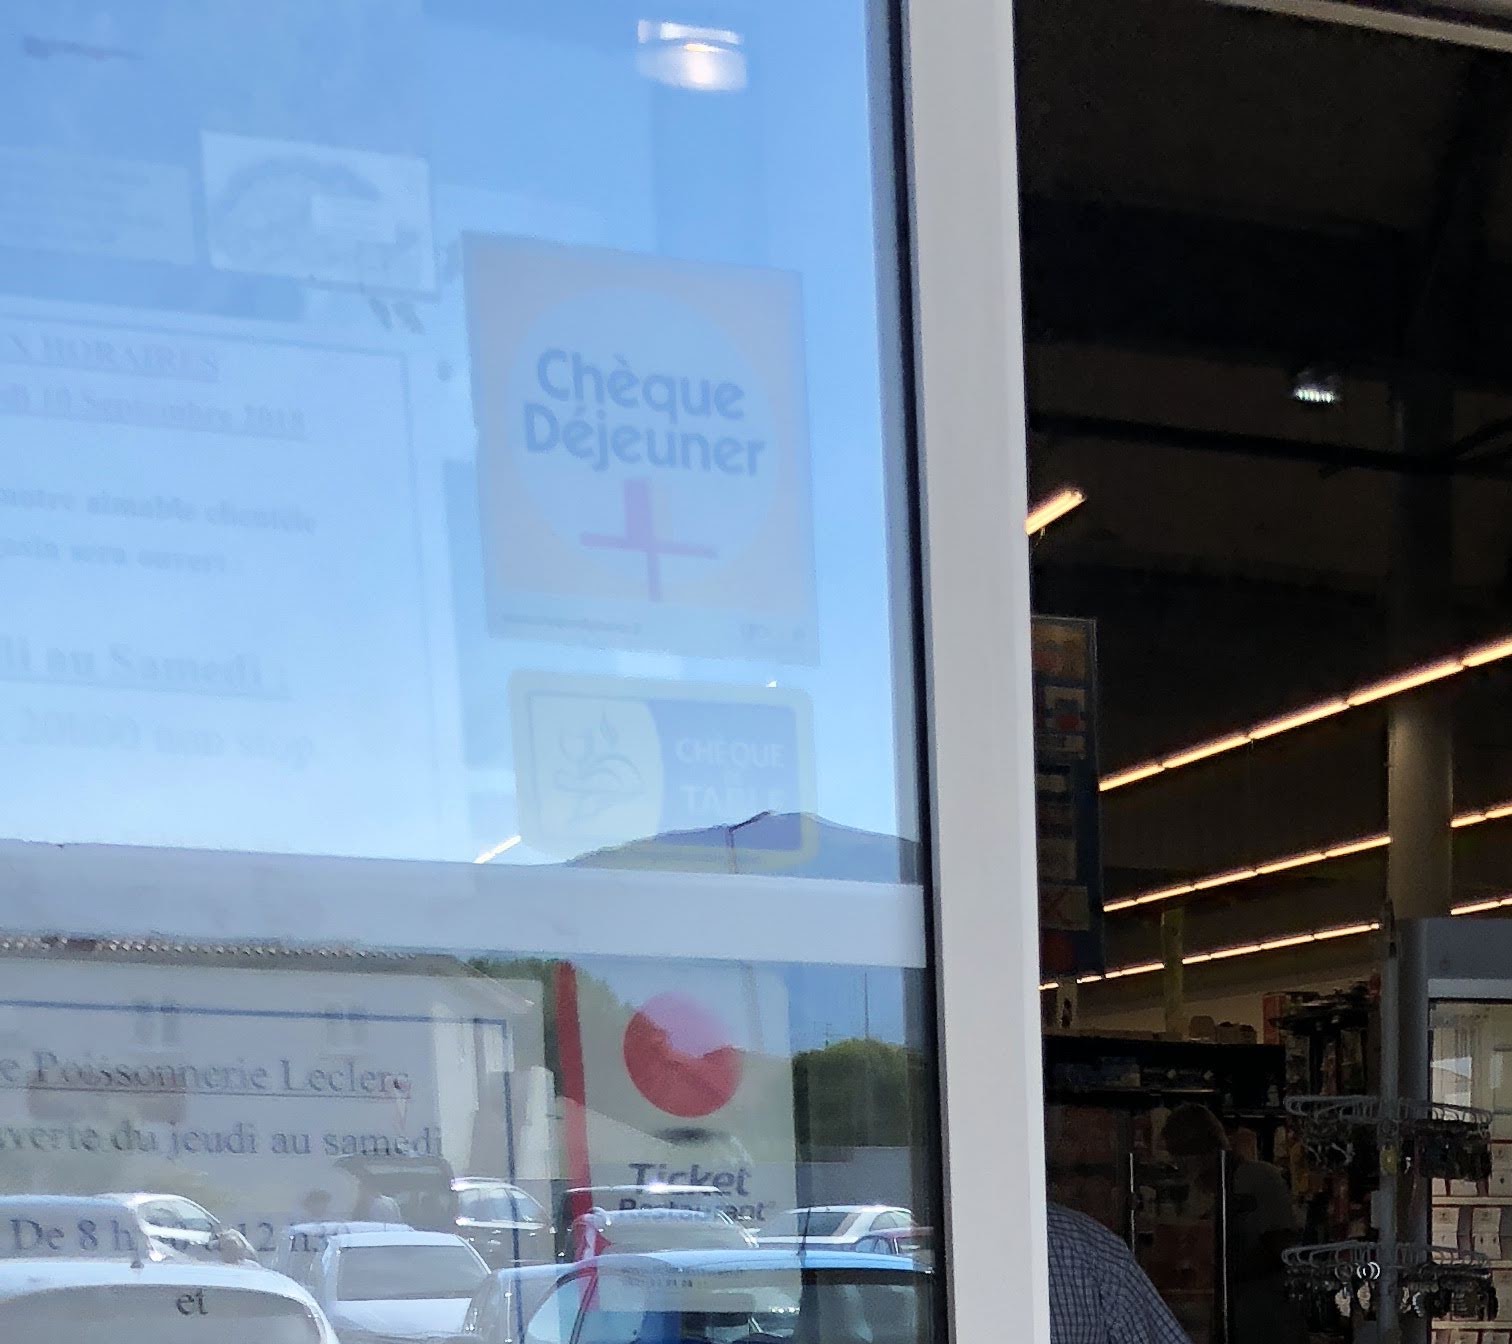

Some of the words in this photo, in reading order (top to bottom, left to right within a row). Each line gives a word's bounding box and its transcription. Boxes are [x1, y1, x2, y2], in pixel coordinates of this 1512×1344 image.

[536, 347, 746, 424] Chèque
[522, 402, 766, 477] Déjeuner
[32, 1050, 268, 1090] Poissonnerie
[280, 1061, 411, 1095] Leclerc
[111, 1121, 159, 1153] du
[164, 1121, 257, 1161] jeudi
[271, 1127, 310, 1155] au
[322, 1127, 442, 1158] samedi
[12, 1218, 65, 1251] De
[76, 1220, 99, 1251] 8
[110, 1219, 136, 1252] h
[175, 1287, 209, 1316] et
